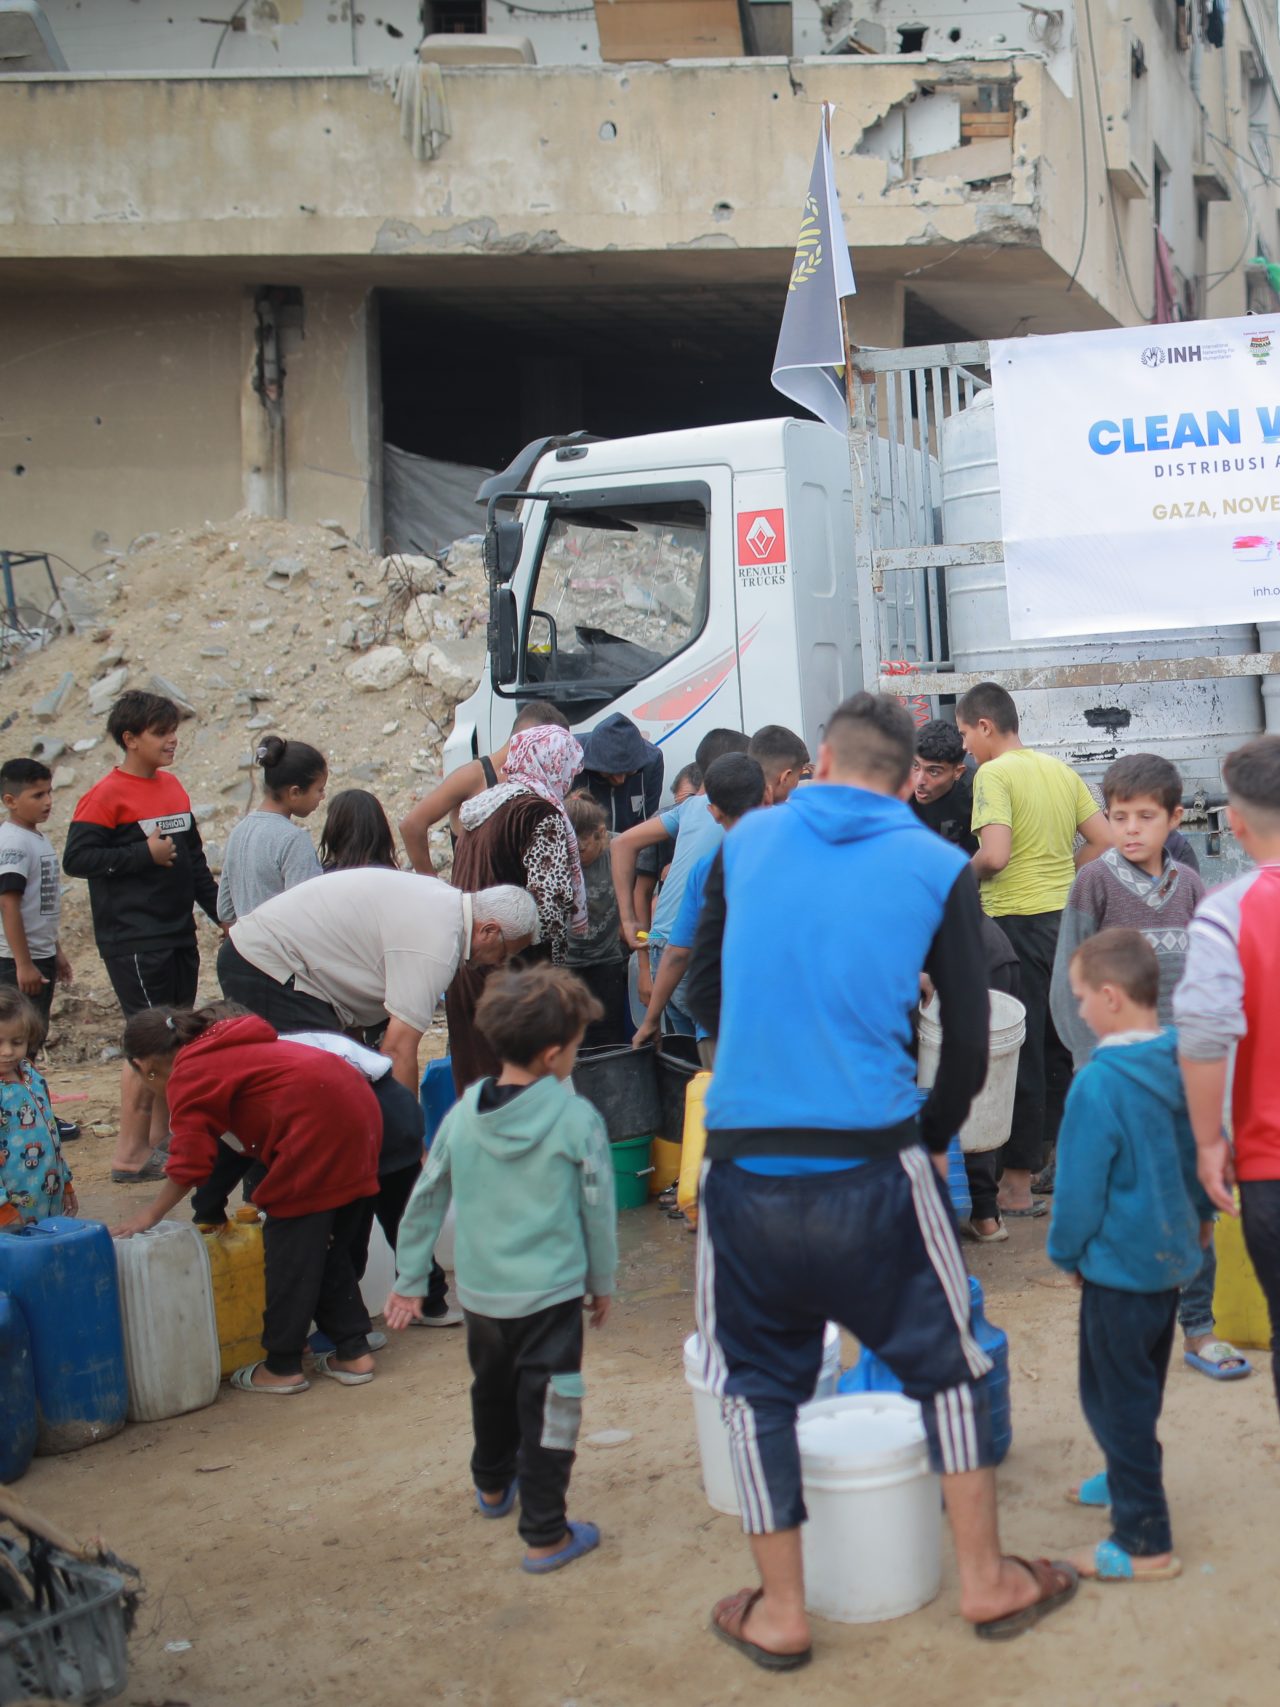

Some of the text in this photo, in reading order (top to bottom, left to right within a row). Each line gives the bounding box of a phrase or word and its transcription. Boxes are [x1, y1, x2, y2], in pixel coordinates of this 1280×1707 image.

[1168, 345, 1202, 364] INH
[1088, 408, 1242, 456] CLEAN
[1154, 456, 1265, 478] DISTRIBUSI
[1152, 500, 1217, 521] GAZA,
[738, 565, 787, 577] RENAULT
[742, 575, 786, 587] TRUCKS
